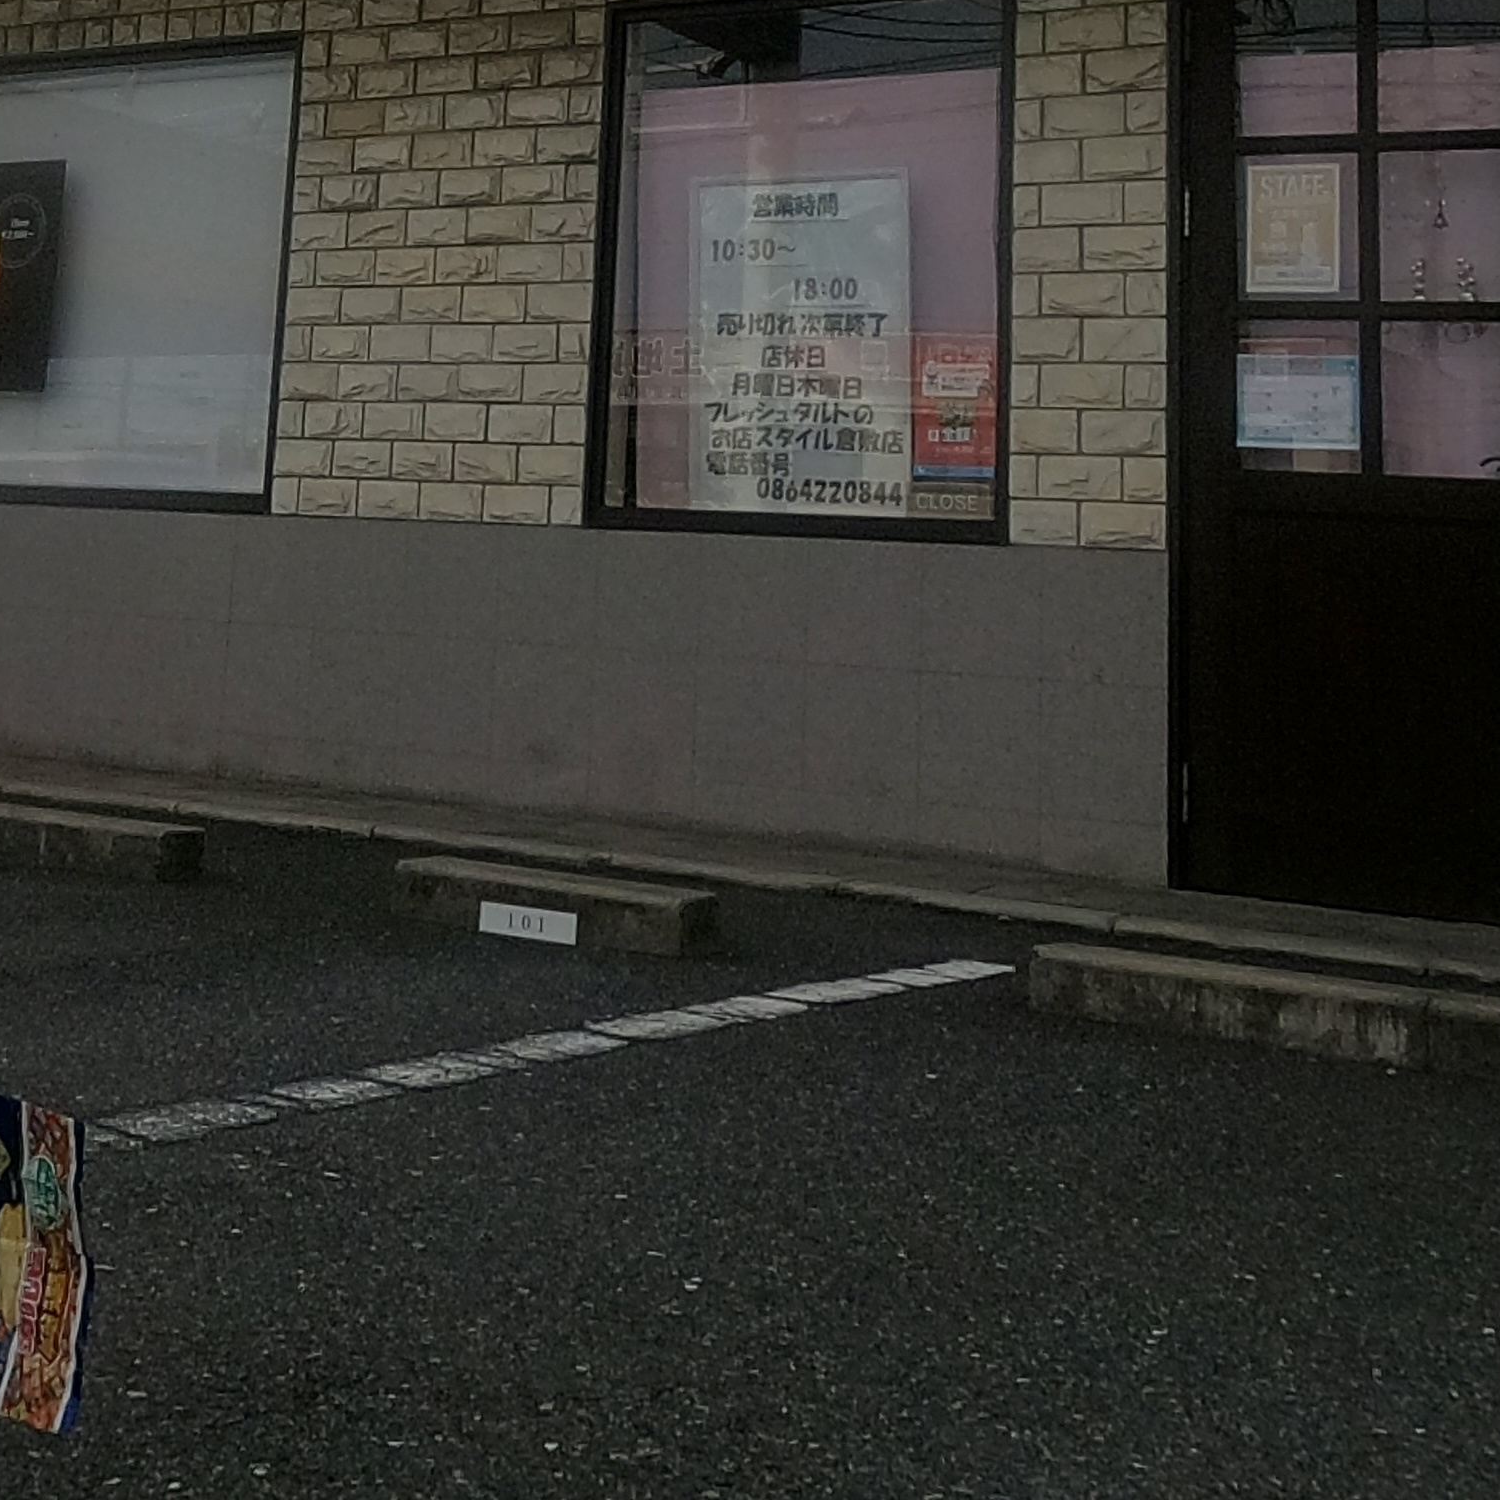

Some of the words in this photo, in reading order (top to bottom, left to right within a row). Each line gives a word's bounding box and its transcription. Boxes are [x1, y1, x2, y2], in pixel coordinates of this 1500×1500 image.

[752, 192, 840, 218] 営業時間
[793, 277, 858, 301] 18:00
[760, 344, 826, 369] 店休日
[704, 401, 874, 425] フレッシュタルトの
[711, 426, 904, 454] お店スタイル倉敷店
[707, 451, 791, 478] 電話番号
[756, 477, 903, 506] 0864220844
[916, 494, 979, 512] CLOSE
